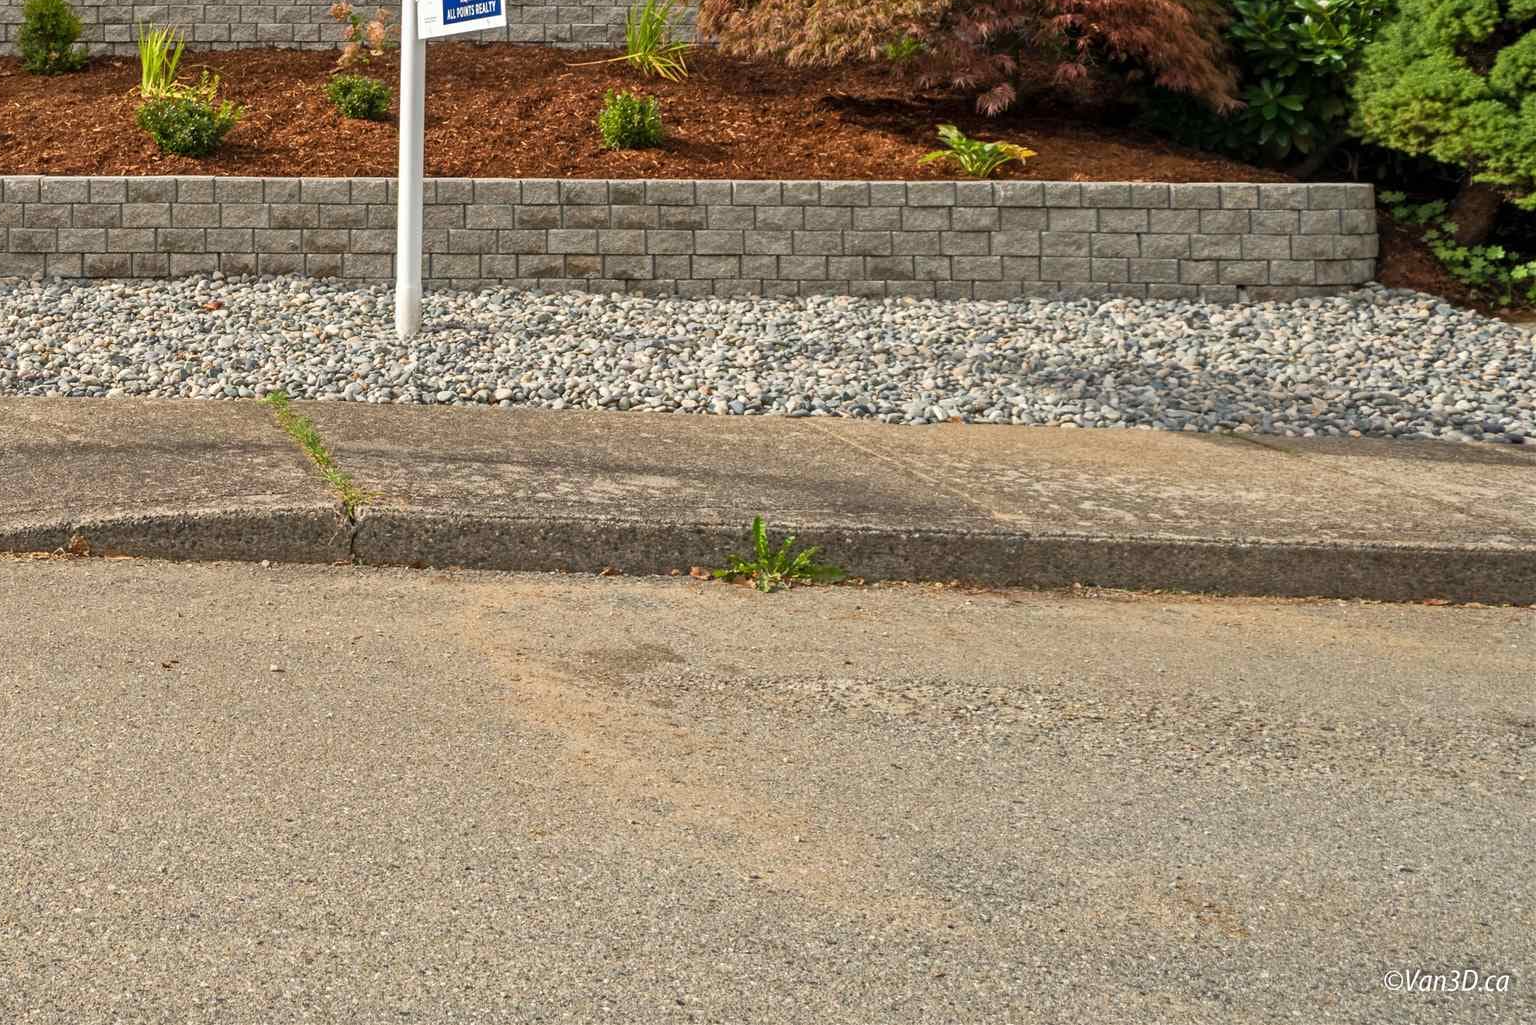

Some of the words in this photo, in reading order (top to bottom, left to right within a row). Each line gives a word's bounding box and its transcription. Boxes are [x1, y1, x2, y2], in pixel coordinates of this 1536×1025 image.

[447, 7, 456, 20] ALL
[456, 4, 475, 18] POINTS
[475, 0, 496, 16] REALTY
